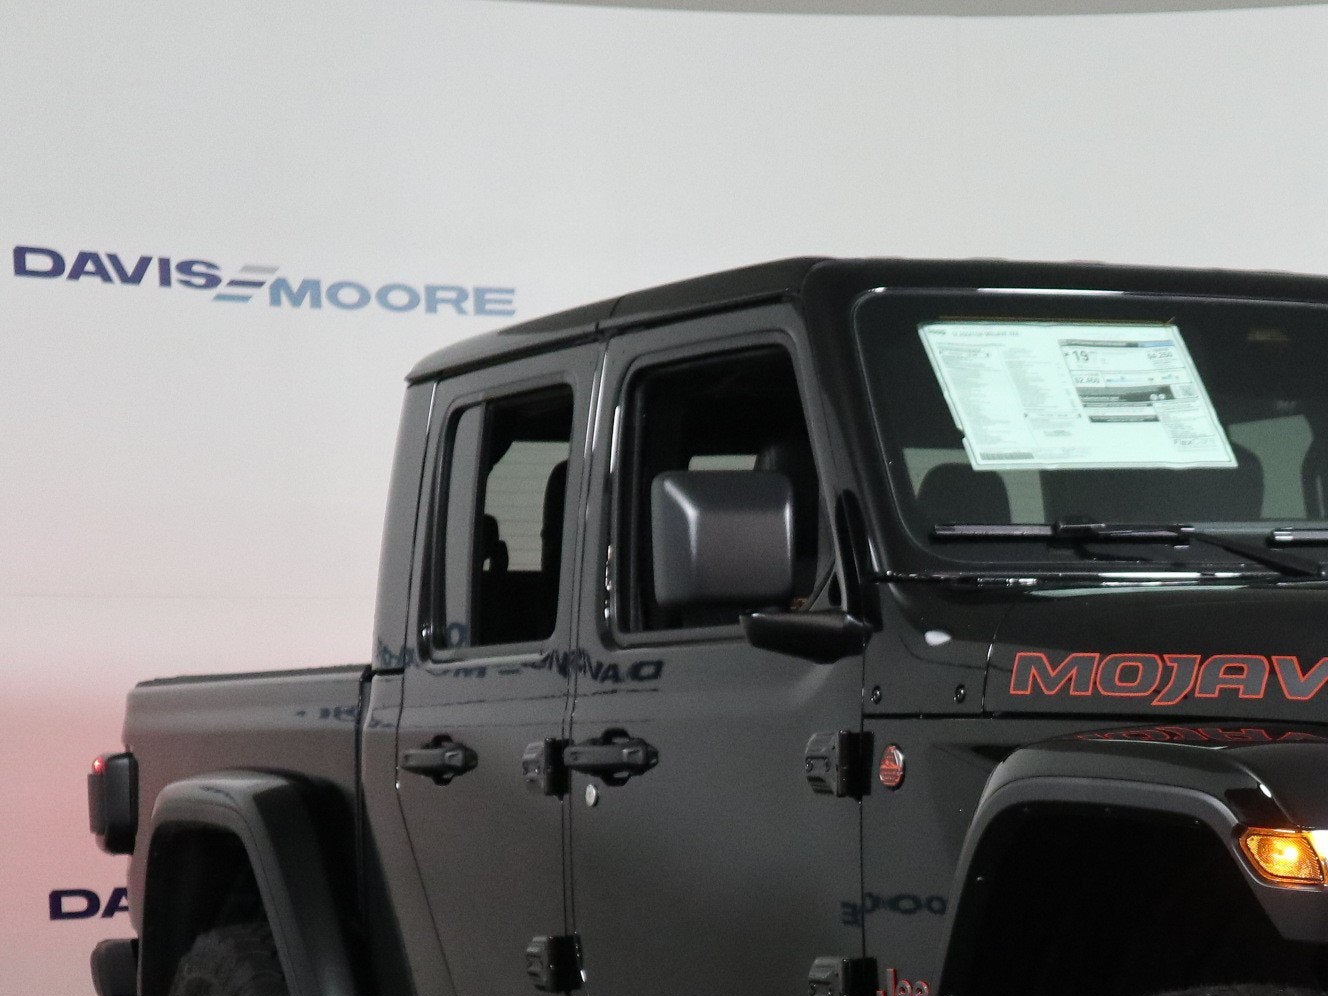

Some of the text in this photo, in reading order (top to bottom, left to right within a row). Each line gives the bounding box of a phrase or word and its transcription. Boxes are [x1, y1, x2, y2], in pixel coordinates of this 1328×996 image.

[13, 245, 517, 317] DAVIS MOORE
[49, 887, 129, 921] DA
